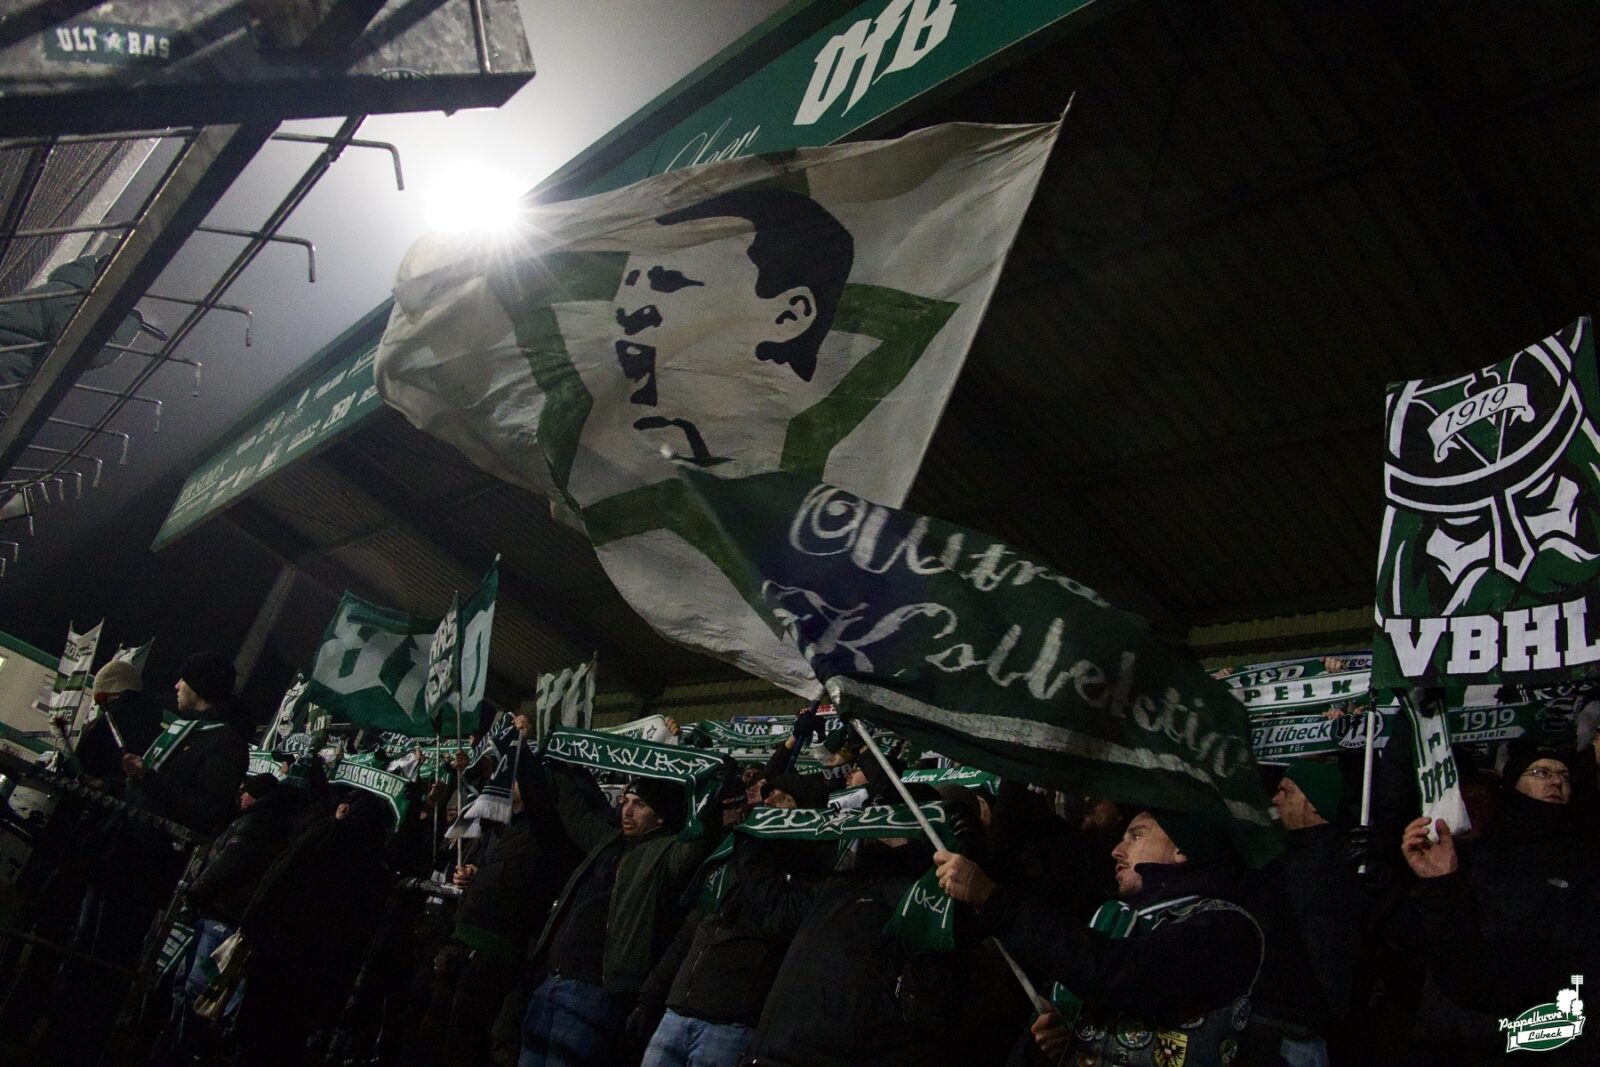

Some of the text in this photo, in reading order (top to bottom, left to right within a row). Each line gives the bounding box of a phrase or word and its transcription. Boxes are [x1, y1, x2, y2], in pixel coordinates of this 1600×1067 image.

[1446, 386, 1508, 432] 1919
[789, 483, 1111, 608] Ultra
[1384, 597, 1600, 678] VBHL
[1265, 721, 1330, 745] Lübeck
[1459, 708, 1517, 731] 1919
[547, 738, 602, 763] ULTRA
[1421, 755, 1457, 804] VfB
